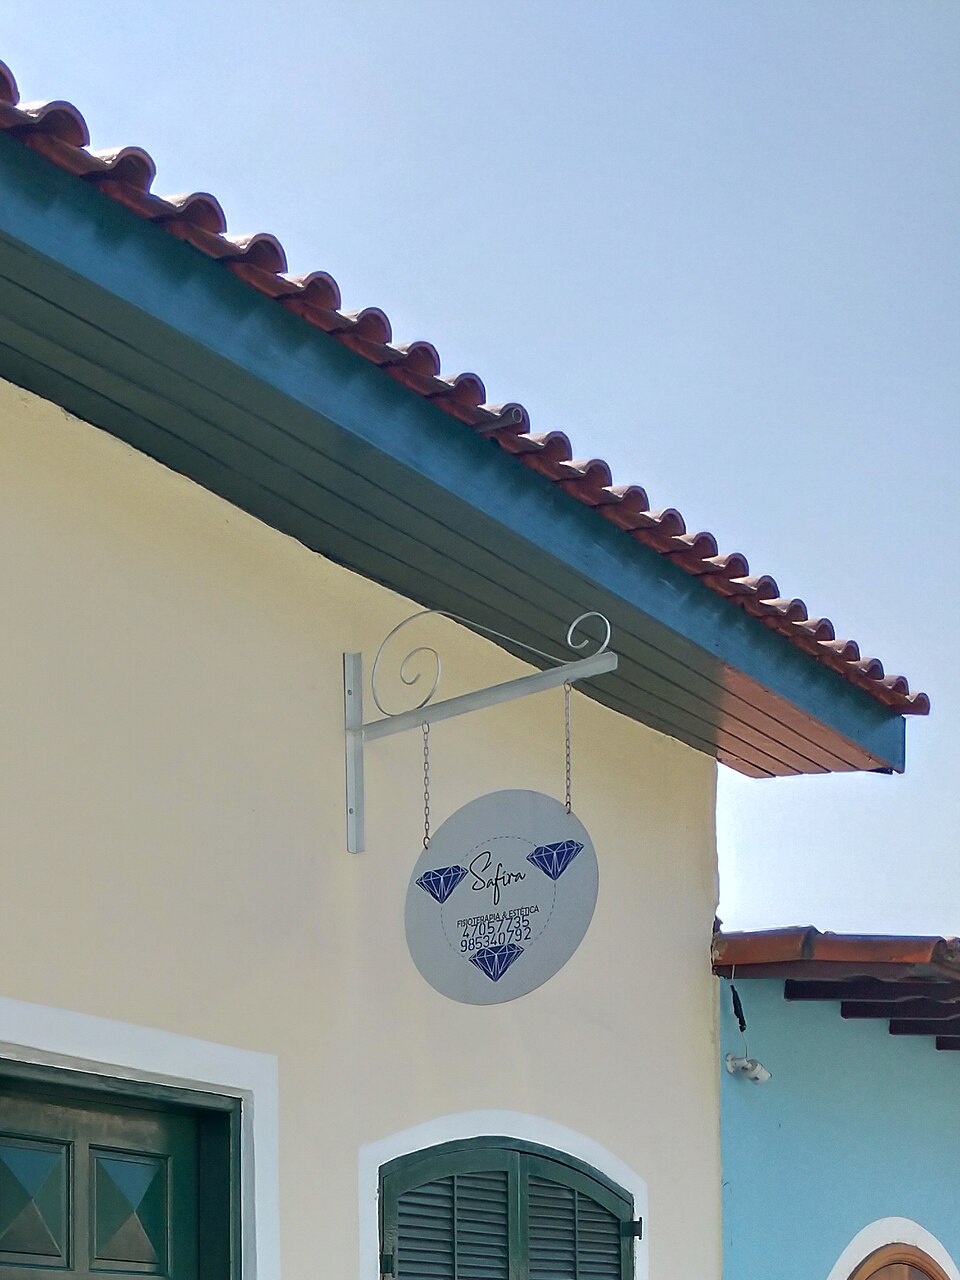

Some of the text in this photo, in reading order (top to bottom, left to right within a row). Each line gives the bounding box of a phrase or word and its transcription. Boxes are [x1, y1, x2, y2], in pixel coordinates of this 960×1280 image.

[469, 850, 527, 905] Safira
[456, 912, 500, 928] FISIOTERAPIA
[462, 915, 530, 939] 47057735
[460, 926, 532, 953] 985340792
